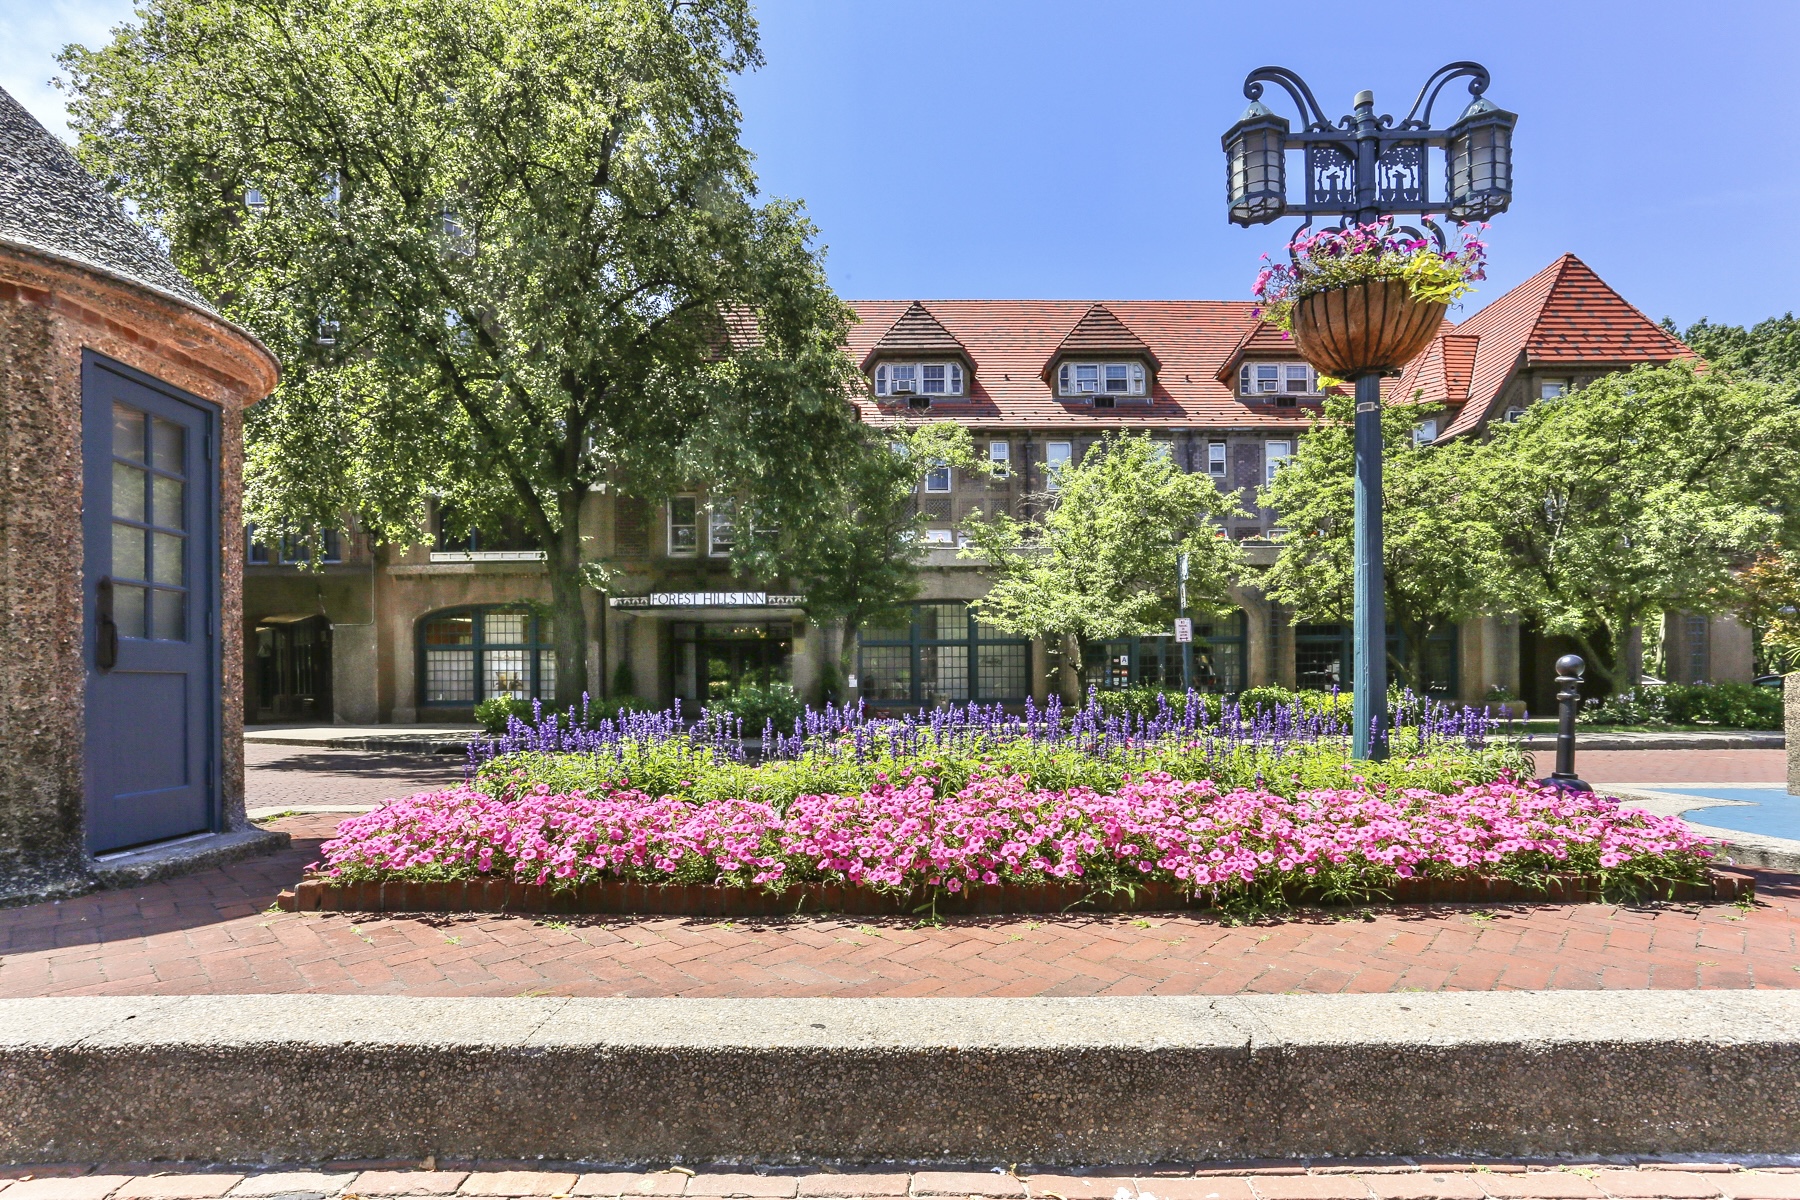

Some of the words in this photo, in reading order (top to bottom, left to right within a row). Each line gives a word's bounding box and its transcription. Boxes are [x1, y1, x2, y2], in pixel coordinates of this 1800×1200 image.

[652, 593, 699, 605] FOREST
[703, 593, 737, 605] HILLS
[743, 593, 765, 605] INN
